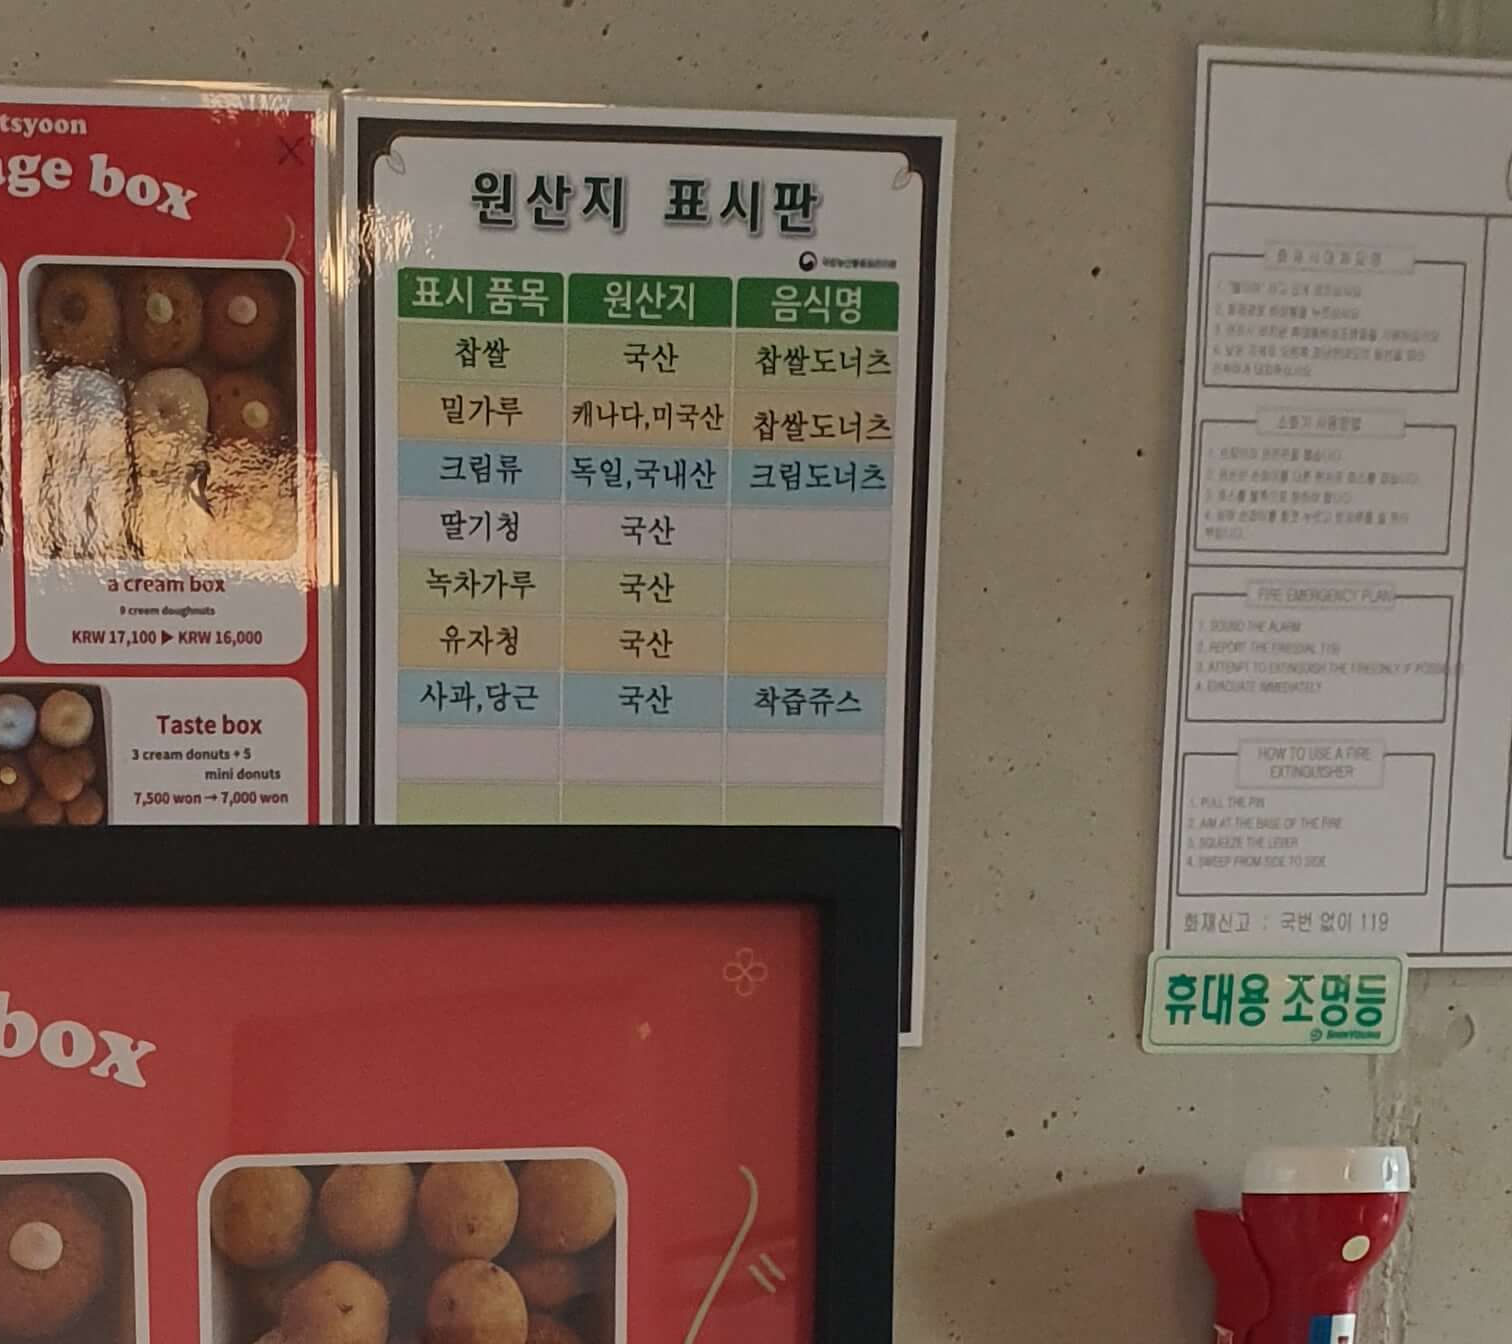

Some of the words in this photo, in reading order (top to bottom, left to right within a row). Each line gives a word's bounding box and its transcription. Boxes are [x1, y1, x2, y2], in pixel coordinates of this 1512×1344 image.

[89, 153, 199, 220] box
[471, 168, 626, 231] 원산지
[662, 174, 821, 236] 표시판
[411, 275, 475, 315] 표시
[486, 278, 550, 318] 품목
[603, 280, 696, 321] 원산지
[770, 285, 864, 325] 음식명
[454, 338, 511, 369] 찹쌀
[622, 342, 679, 374] 국산
[755, 345, 893, 378] 찹쌀도너츠
[440, 395, 525, 429] 밀가루
[571, 400, 725, 433] 캐나다,미국산
[752, 409, 894, 444] 찹쌀도너츠
[439, 453, 523, 486] 크림류
[570, 457, 717, 490] 독일,국내산
[750, 460, 887, 492] 크림도너츠
[440, 510, 521, 542] 딸기청
[620, 515, 676, 546] 국산
[107, 579, 119, 592] a
[123, 577, 185, 592] cream
[189, 575, 226, 593] box
[426, 568, 537, 600] 녹차가루
[619, 572, 675, 603] 국산
[162, 605, 216, 618] doughnuts
[72, 630, 106, 644] KRW
[109, 630, 157, 647] 17,100
[178, 630, 212, 644] KRW
[215, 630, 263, 647] 16,000
[439, 625, 521, 657] 유자청
[619, 628, 673, 660] 국산
[419, 680, 540, 714] 사과,당근
[618, 684, 673, 716] 국산
[754, 686, 864, 717] 착즙쥬스
[156, 715, 217, 735] Taste
[222, 714, 263, 735] box
[131, 749, 139, 760] 3
[142, 750, 183, 761] cream
[185, 749, 230, 760] donuts
[243, 748, 252, 760] 5
[204, 767, 234, 780] mini
[236, 767, 281, 780] donuts
[134, 792, 170, 807] 7,500
[173, 793, 202, 804] won
[221, 791, 257, 807] 7,000
[259, 792, 289, 804] won
[1184, 912, 1250, 933] 화재신고
[1281, 912, 1313, 932] 국번
[1320, 912, 1353, 933] 없이
[1361, 912, 1389, 932] 119
[1165, 973, 1270, 1028] 휴대용
[1282, 973, 1387, 1028] 조명등
